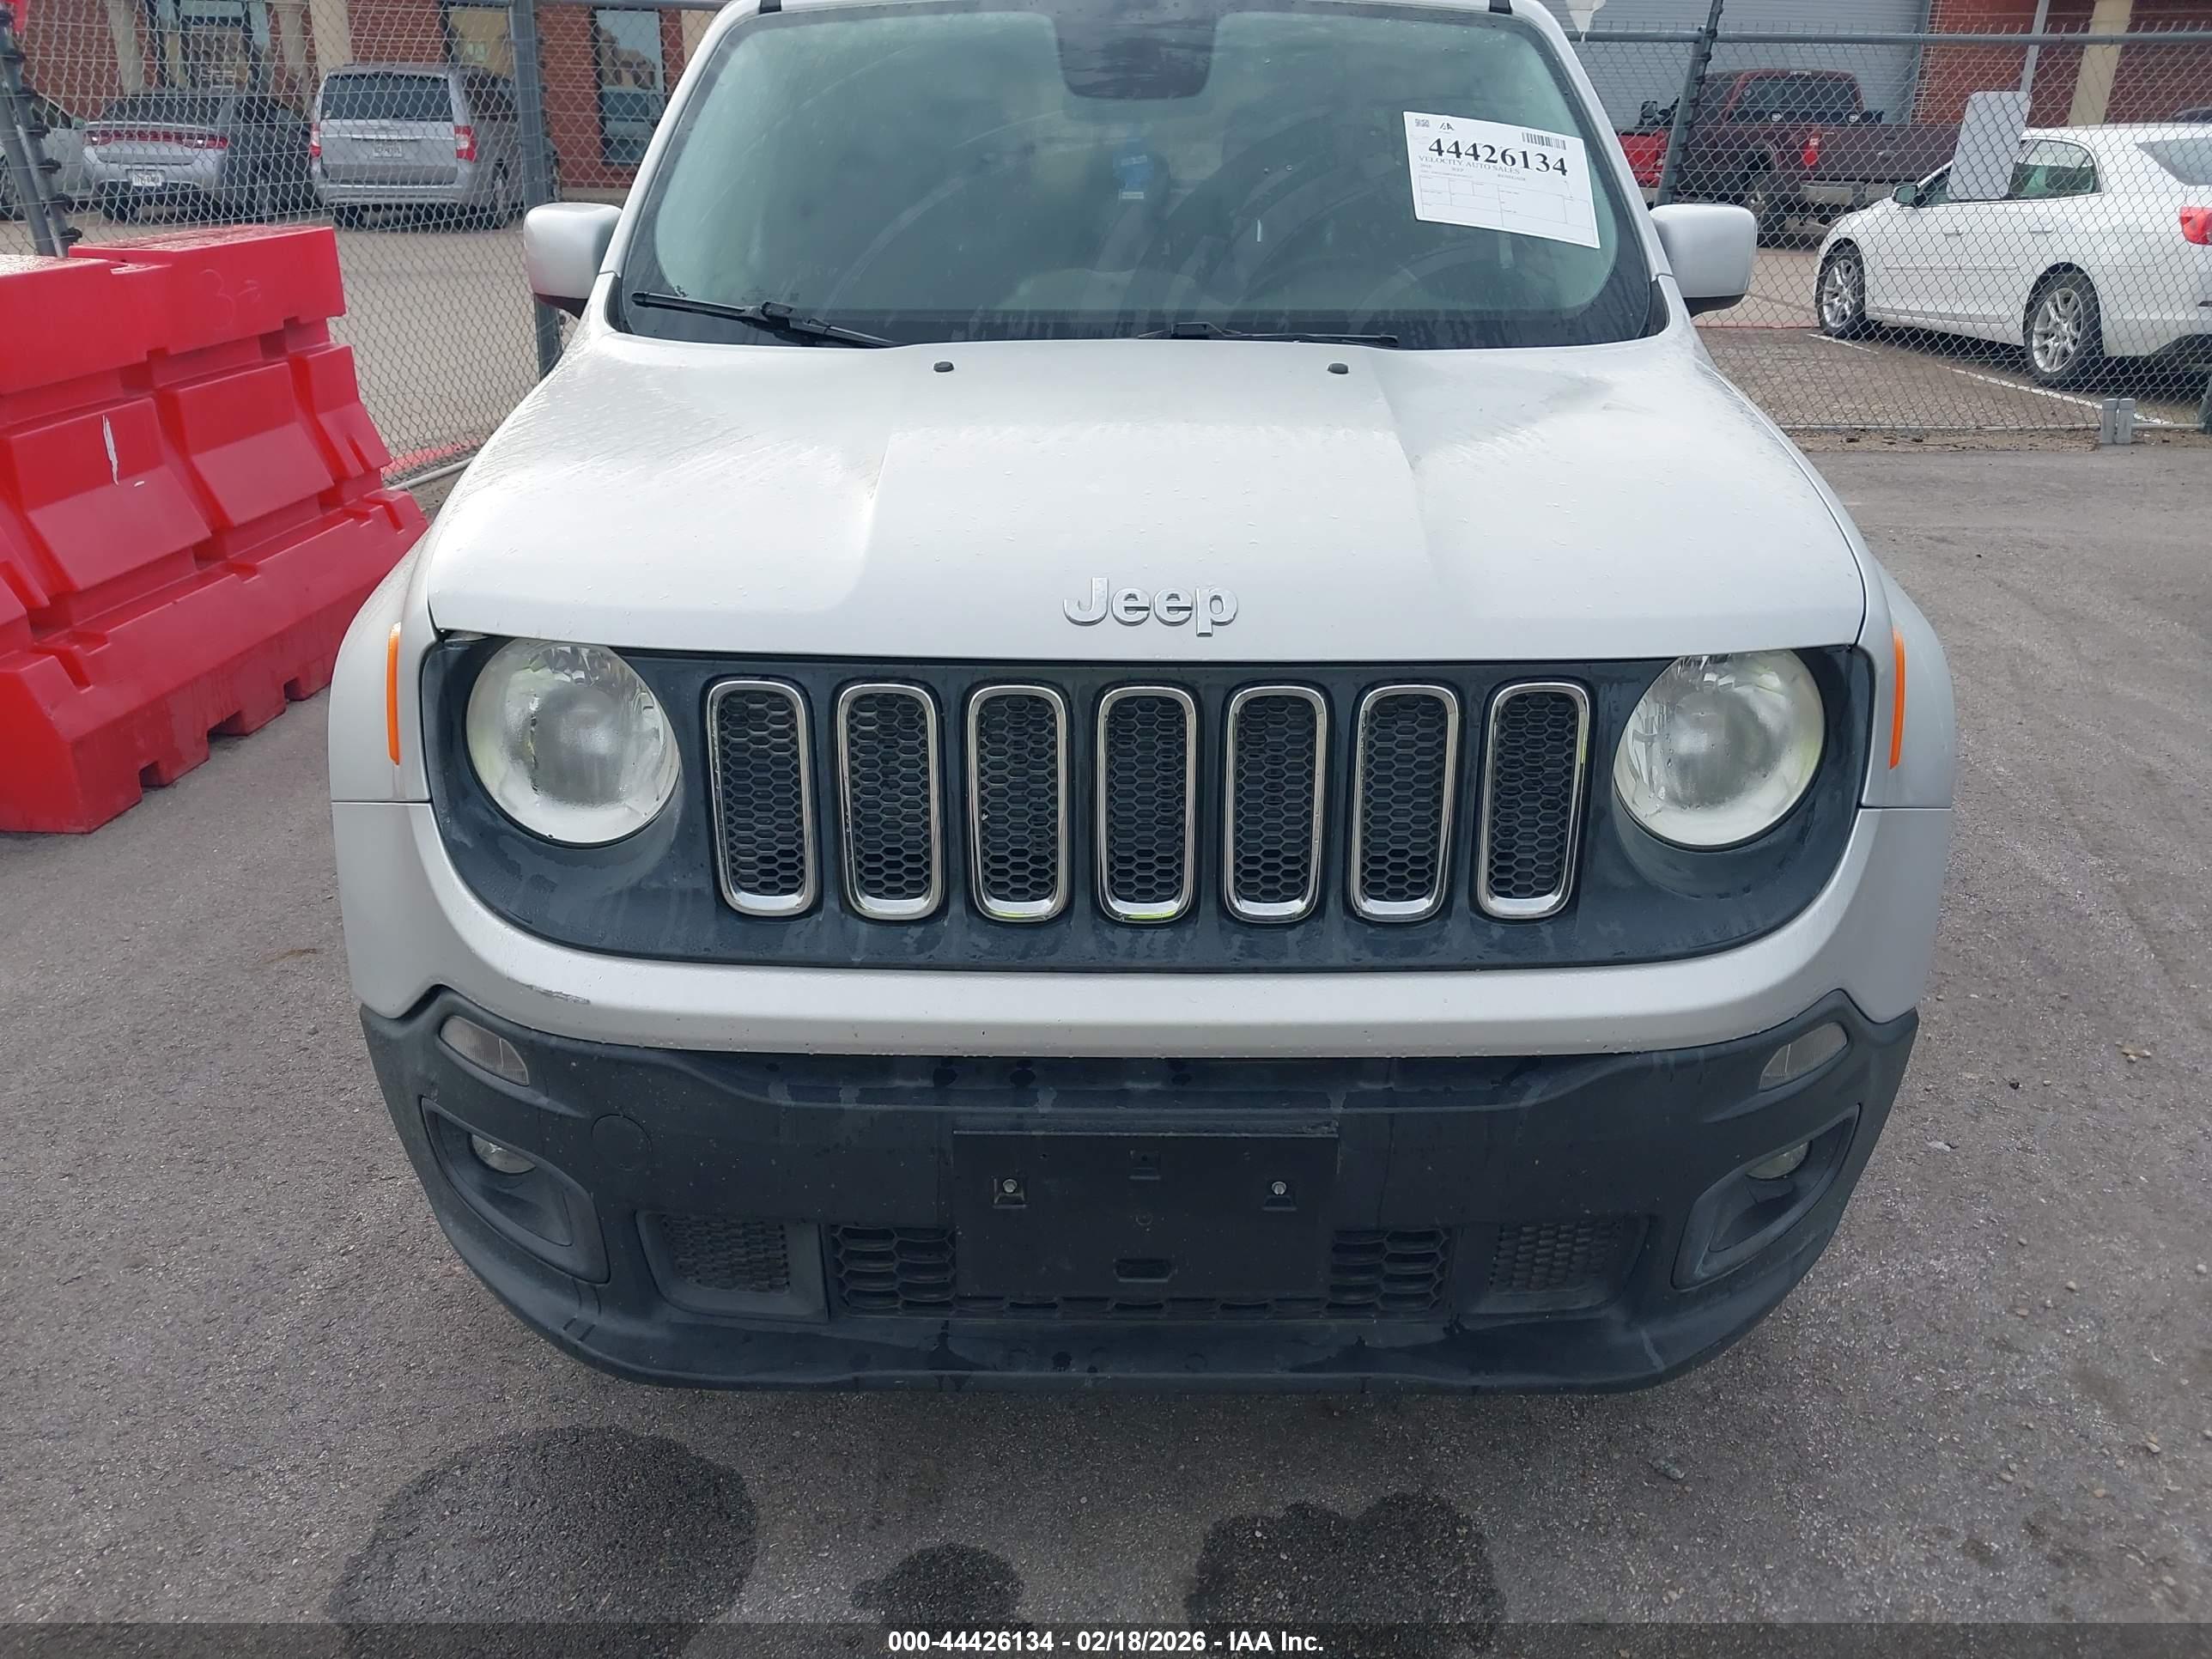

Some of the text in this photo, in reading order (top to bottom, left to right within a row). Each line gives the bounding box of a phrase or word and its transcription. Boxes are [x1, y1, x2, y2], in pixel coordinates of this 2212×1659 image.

[1419, 155, 1463, 166] VELOCITY
[1465, 161, 1491, 170] AUTO
[1492, 165, 1521, 175] SALES
[1428, 137, 1568, 176] 44426134
[1063, 576, 1238, 637] Jeep
